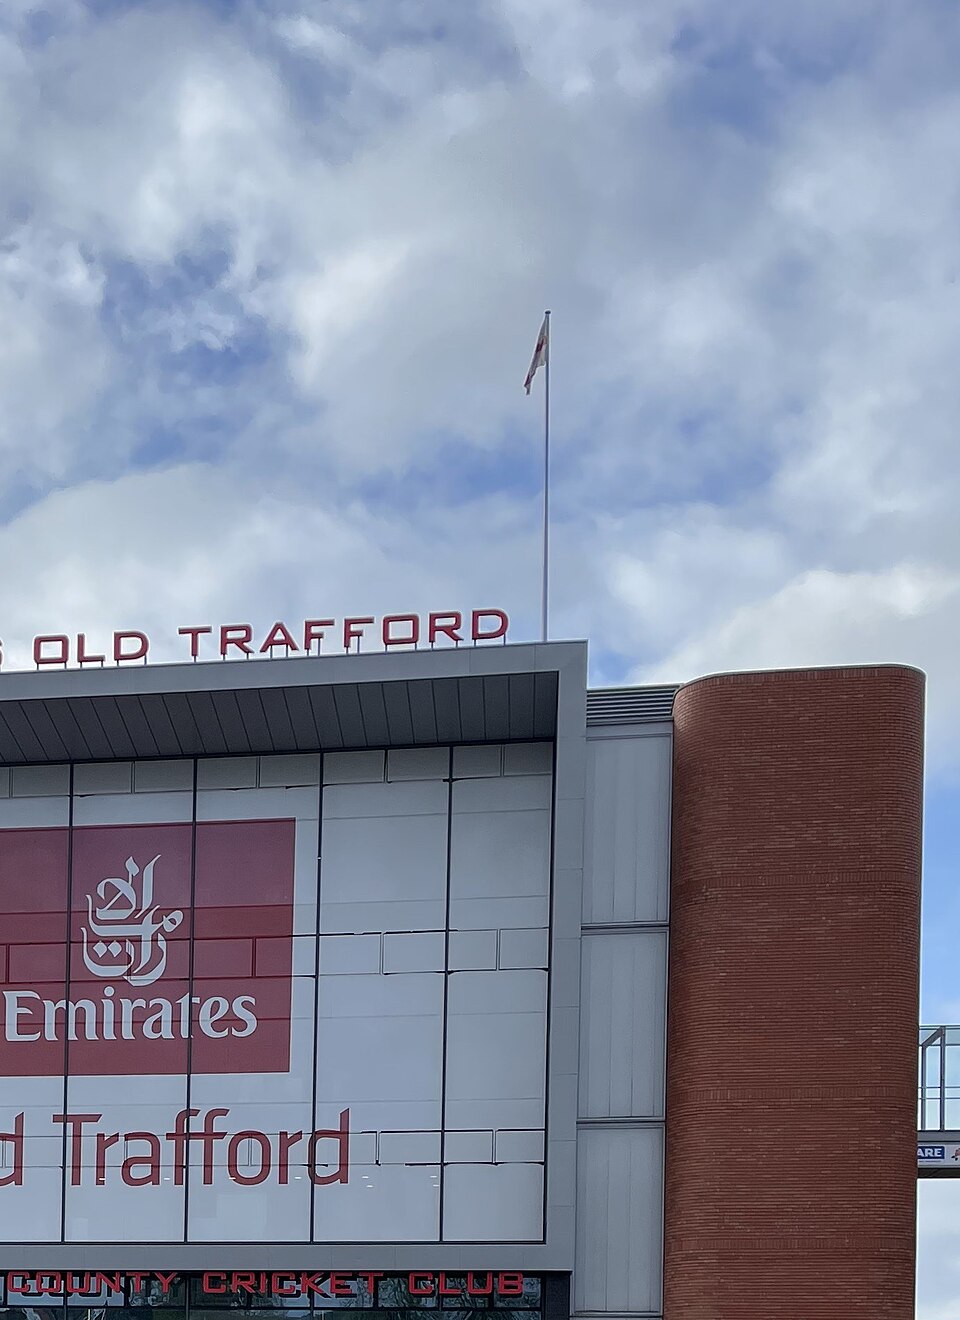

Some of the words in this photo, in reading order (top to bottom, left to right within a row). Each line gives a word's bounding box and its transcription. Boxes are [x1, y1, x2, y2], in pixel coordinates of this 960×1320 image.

[33, 631, 150, 665] OLD
[178, 608, 509, 658] TRAFFORD
[2, 986, 258, 1042] Emirates
[52, 1107, 350, 1187] Trafford
[7, 1271, 179, 1293] COUNTY
[202, 1272, 384, 1294] CRICKET
[408, 1272, 524, 1294] CLUB
